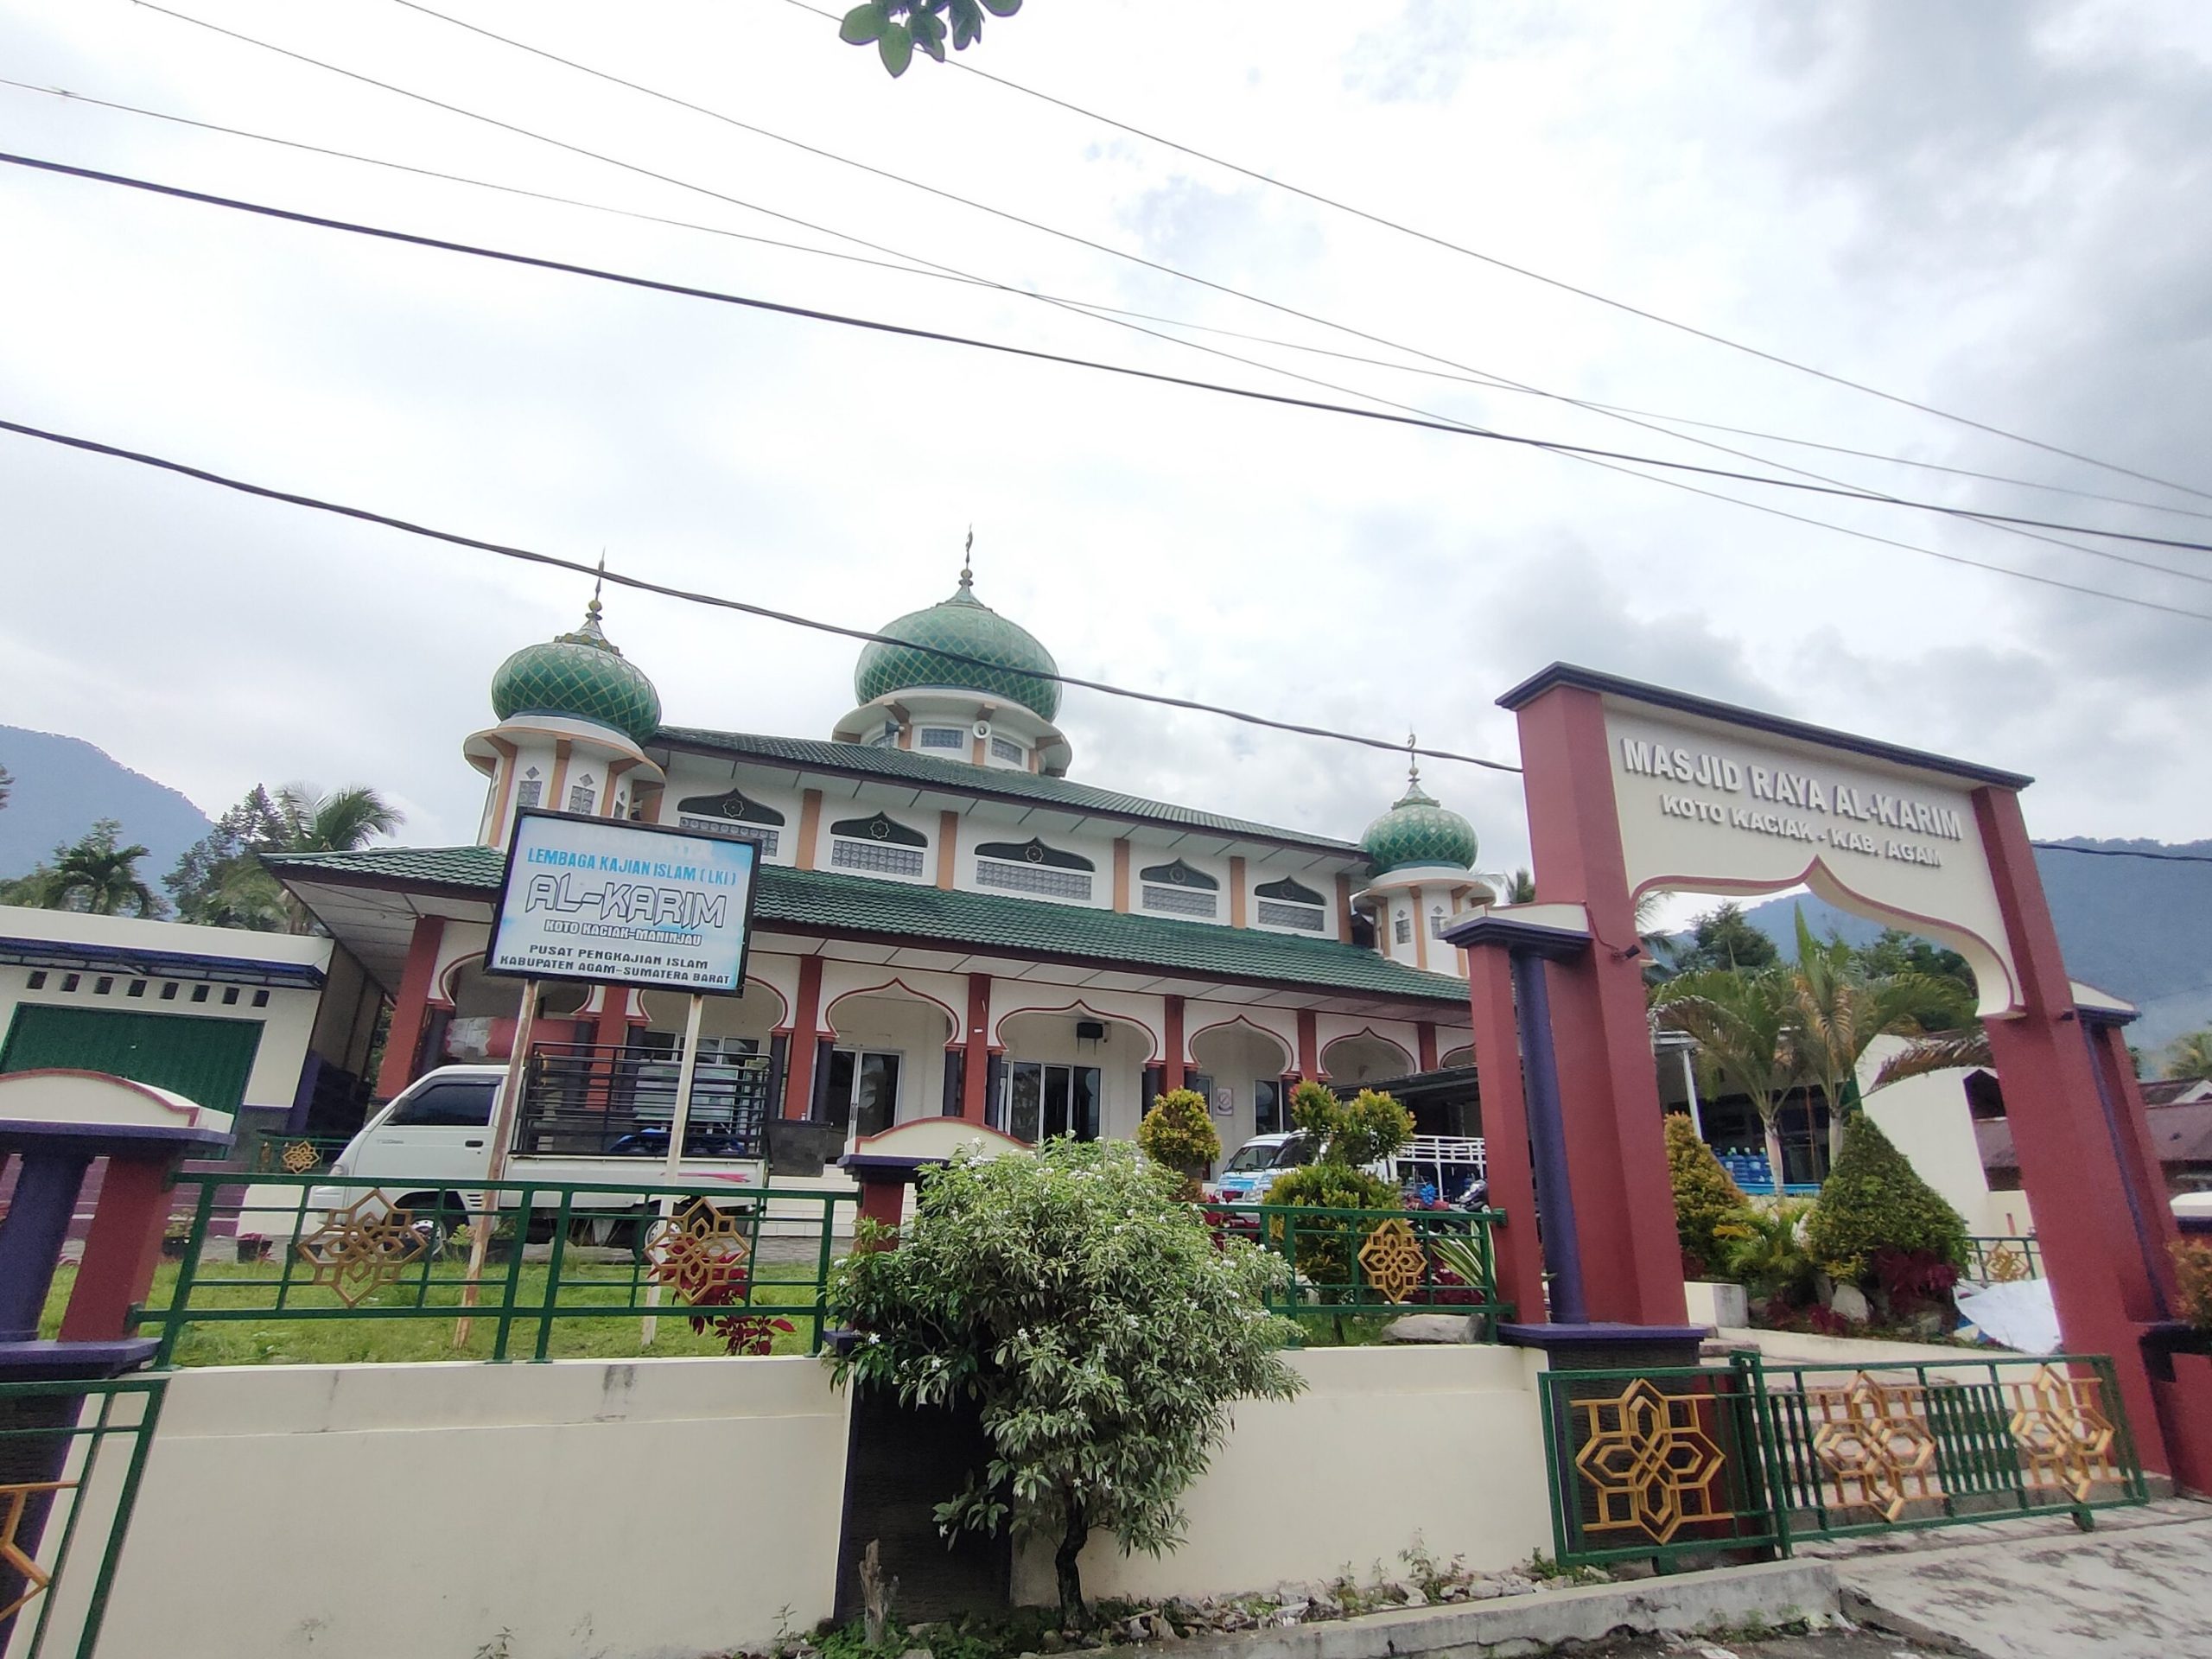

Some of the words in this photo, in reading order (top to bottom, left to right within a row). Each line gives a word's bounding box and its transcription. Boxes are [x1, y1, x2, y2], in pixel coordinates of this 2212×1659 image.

[1621, 738, 1742, 792] MASJID
[1747, 765, 1828, 813] RAYA
[1833, 785, 1964, 842] AL-KARIM
[1660, 793, 1726, 824] KOTO
[1729, 807, 1814, 843] KACIAK
[1827, 827, 1882, 857] KAB.
[1885, 839, 1942, 868] AGAM
[527, 847, 596, 869] LEMBAGA
[599, 855, 651, 876] KAJIAN
[653, 862, 696, 881] ISLAM
[525, 872, 727, 930] AL-KARIM
[543, 918, 581, 934] KOTO
[581, 922, 702, 947] KACIAK-MANINJAU
[499, 955, 574, 970] KABUPATEN
[577, 962, 690, 981] AGAM-SUMATERA
[692, 972, 730, 984] BARAT
[529, 944, 575, 957] PUSAT
[577, 949, 662, 966] PENGKAJIAN
[666, 957, 709, 969] ISLAM
